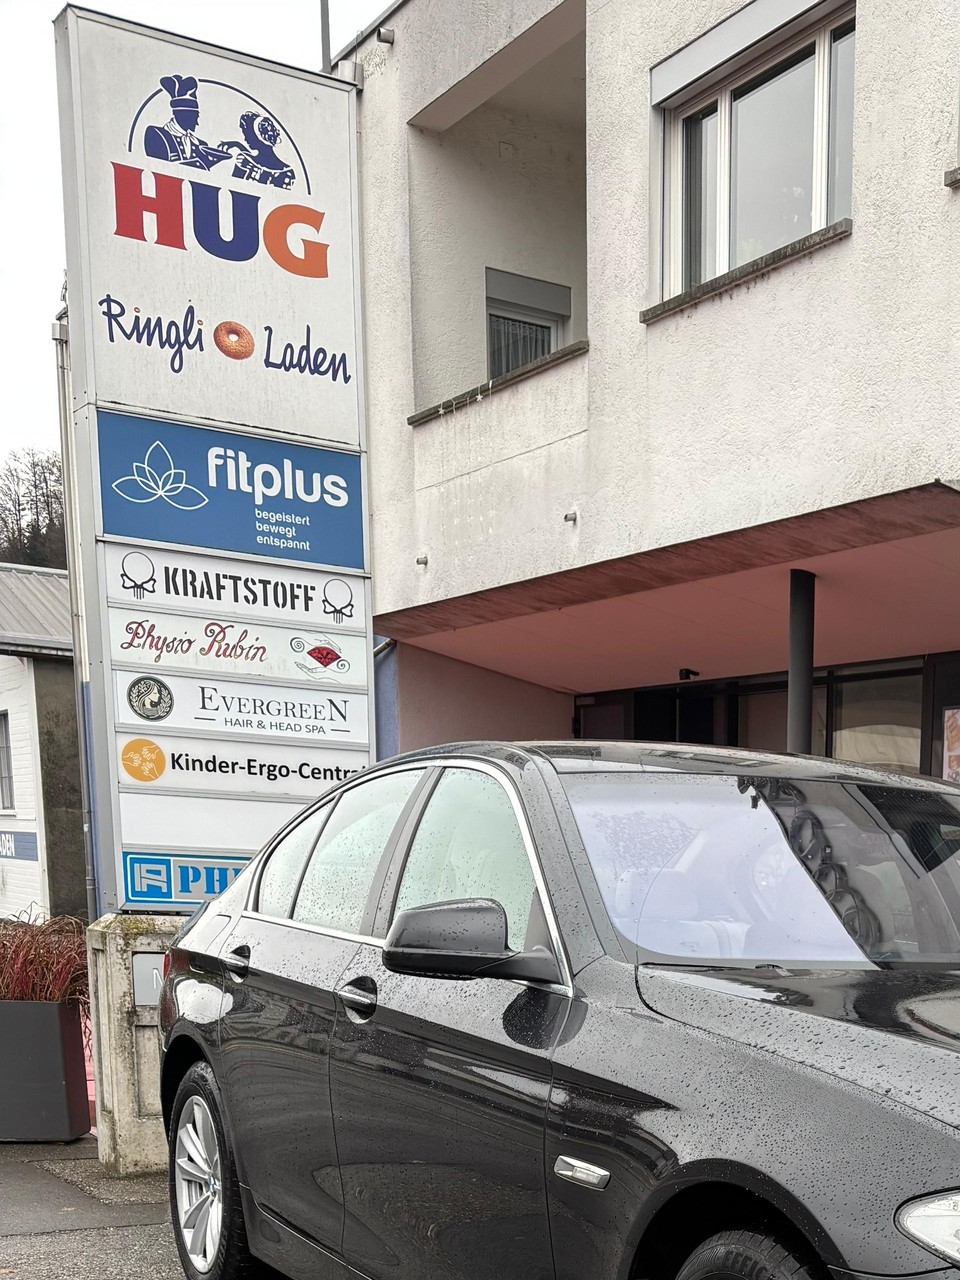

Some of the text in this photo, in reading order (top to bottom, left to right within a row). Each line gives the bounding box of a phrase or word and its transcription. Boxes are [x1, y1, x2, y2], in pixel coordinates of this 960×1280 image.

[110, 161, 330, 278] HUG
[98, 294, 351, 384] Ringli Laden
[207, 446, 349, 507] fitplus
[255, 508, 310, 526] begeistert
[255, 521, 296, 537] bewegt
[256, 535, 311, 550] entspannt
[164, 566, 316, 612] KRAFTSTOFF
[120, 619, 268, 663] Physio Rubin
[224, 717, 326, 735] HAIR & HEAD SPA
[171, 753, 366, 781] Kinder-Ergo-Centr
[178, 866, 242, 895] PH
